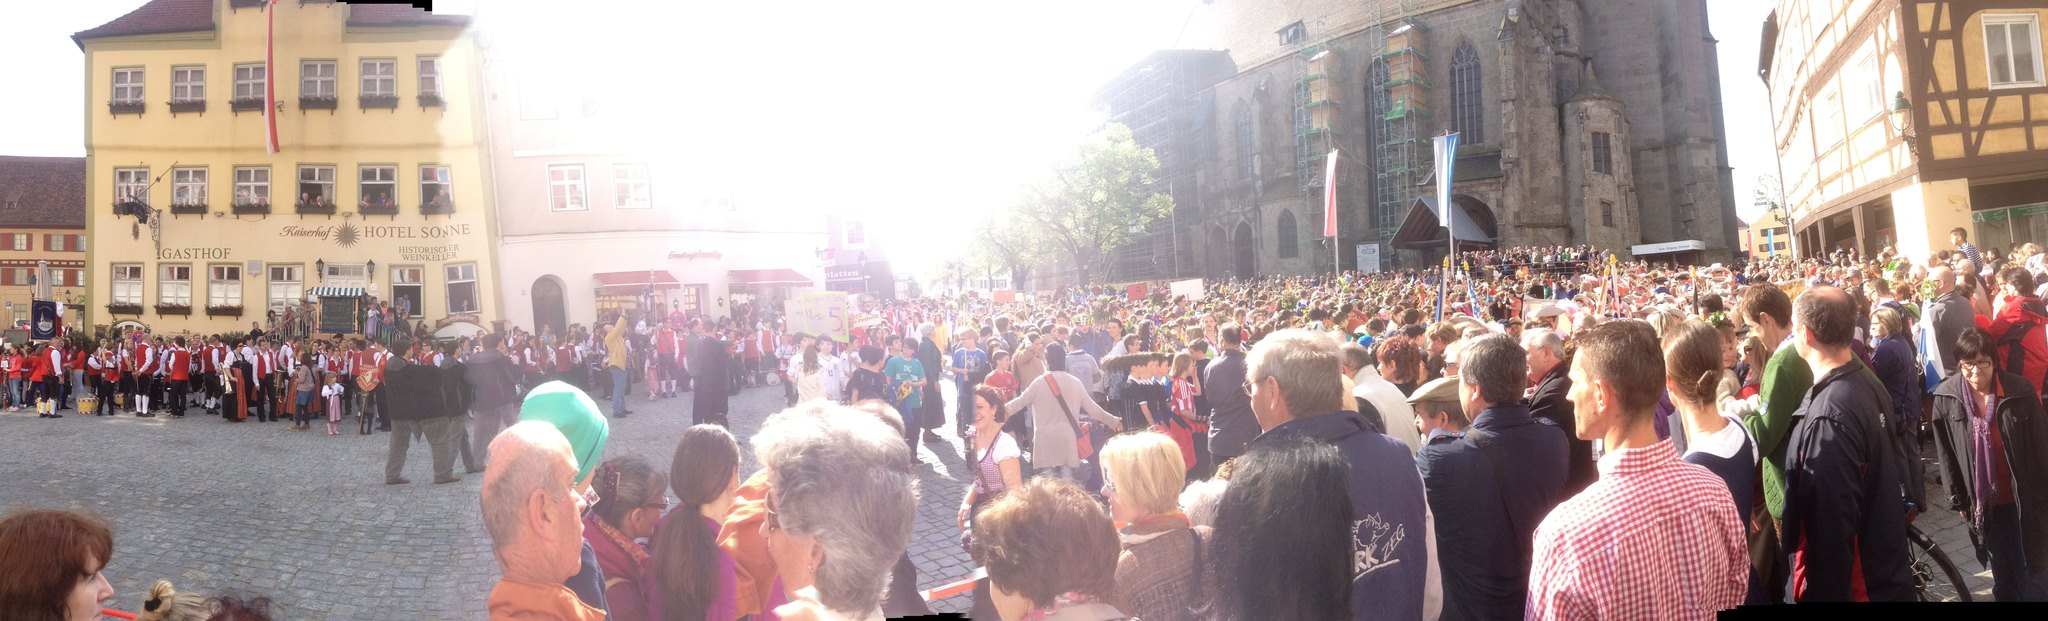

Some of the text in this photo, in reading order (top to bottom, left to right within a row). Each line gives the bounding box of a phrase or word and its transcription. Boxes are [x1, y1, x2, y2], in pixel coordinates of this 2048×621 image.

[279, 225, 334, 241] Kaiserhof
[364, 225, 416, 239] HOTEL
[162, 247, 232, 260] GASTHOF
[1381, 523, 1405, 562] ZEG
[1354, 544, 1379, 573] RK
